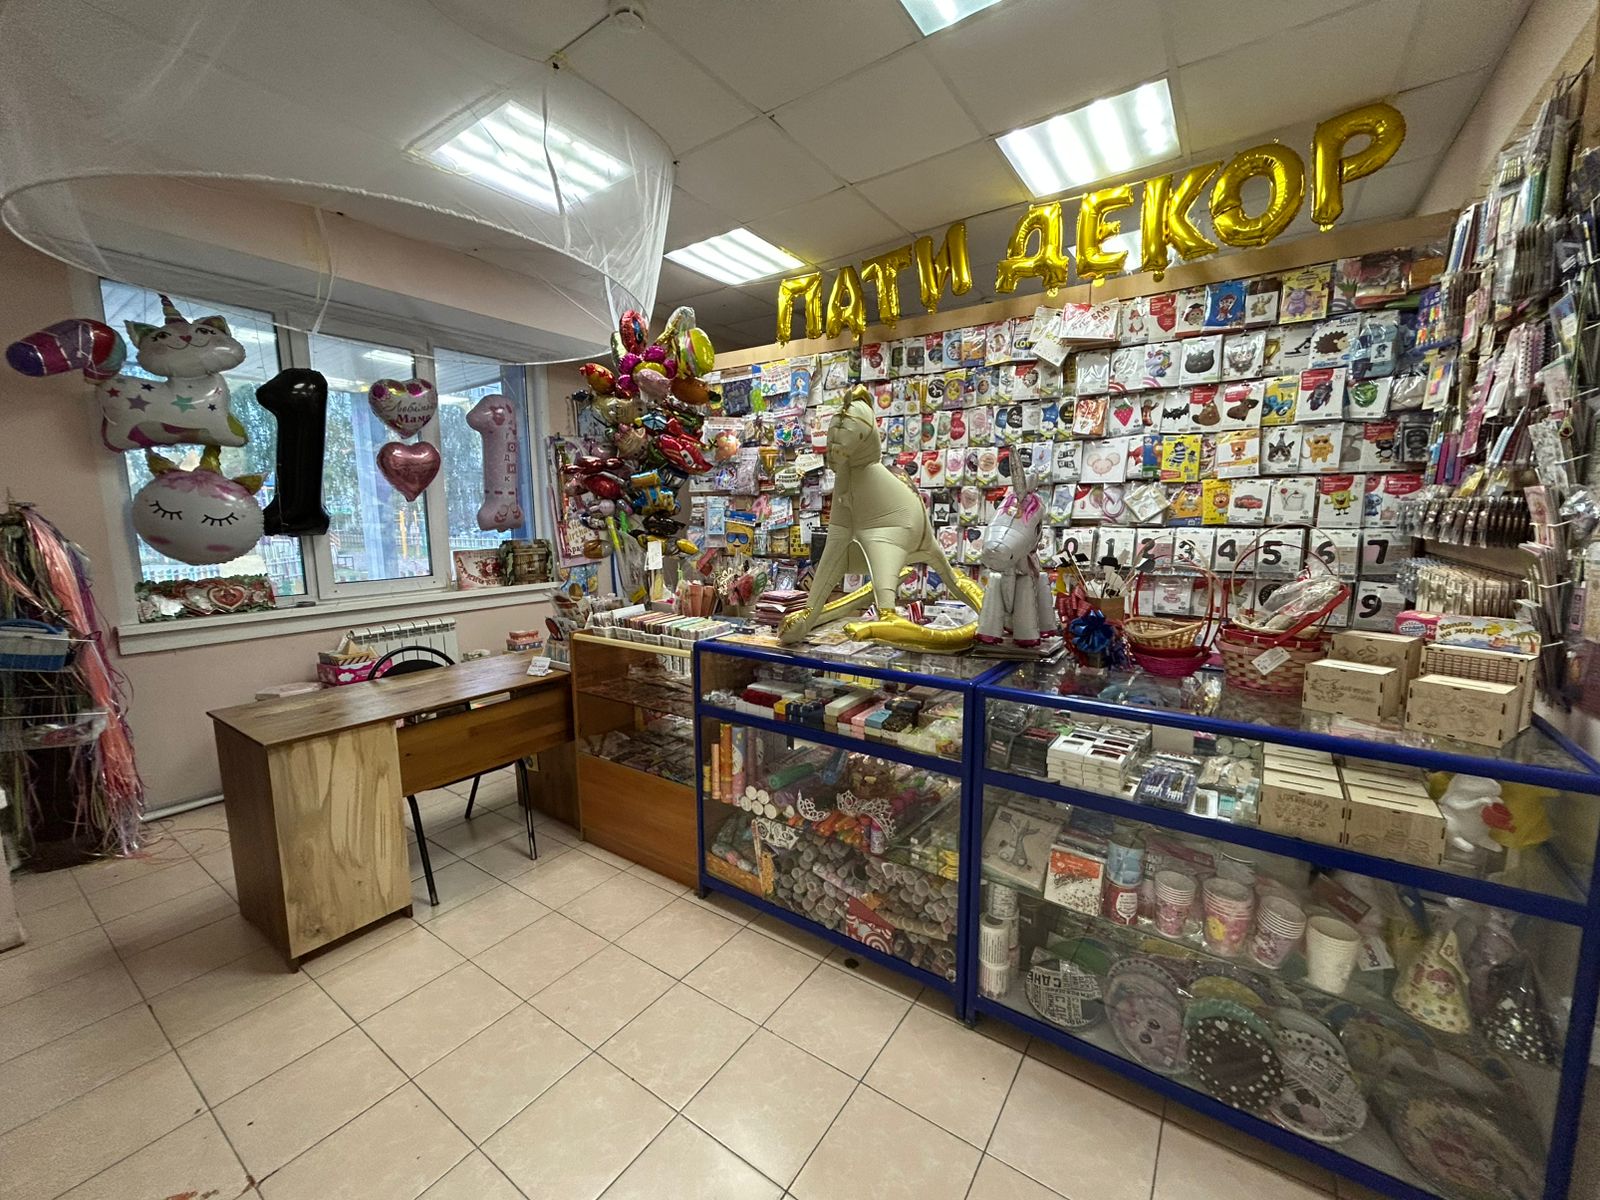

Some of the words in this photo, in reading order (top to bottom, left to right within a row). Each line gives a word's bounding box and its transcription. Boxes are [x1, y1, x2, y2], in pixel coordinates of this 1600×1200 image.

[776, 220, 972, 344] ПАТИ
[995, 102, 1406, 296] ДЕКОР
[1218, 539, 1239, 562] 4
[1261, 540, 1283, 565] 5
[1315, 540, 1336, 565] 6
[1367, 539, 1390, 565] 7
[1358, 594, 1383, 619] 9
[1440, 631, 1452, 639] на
[1454, 627, 1486, 635] море!
